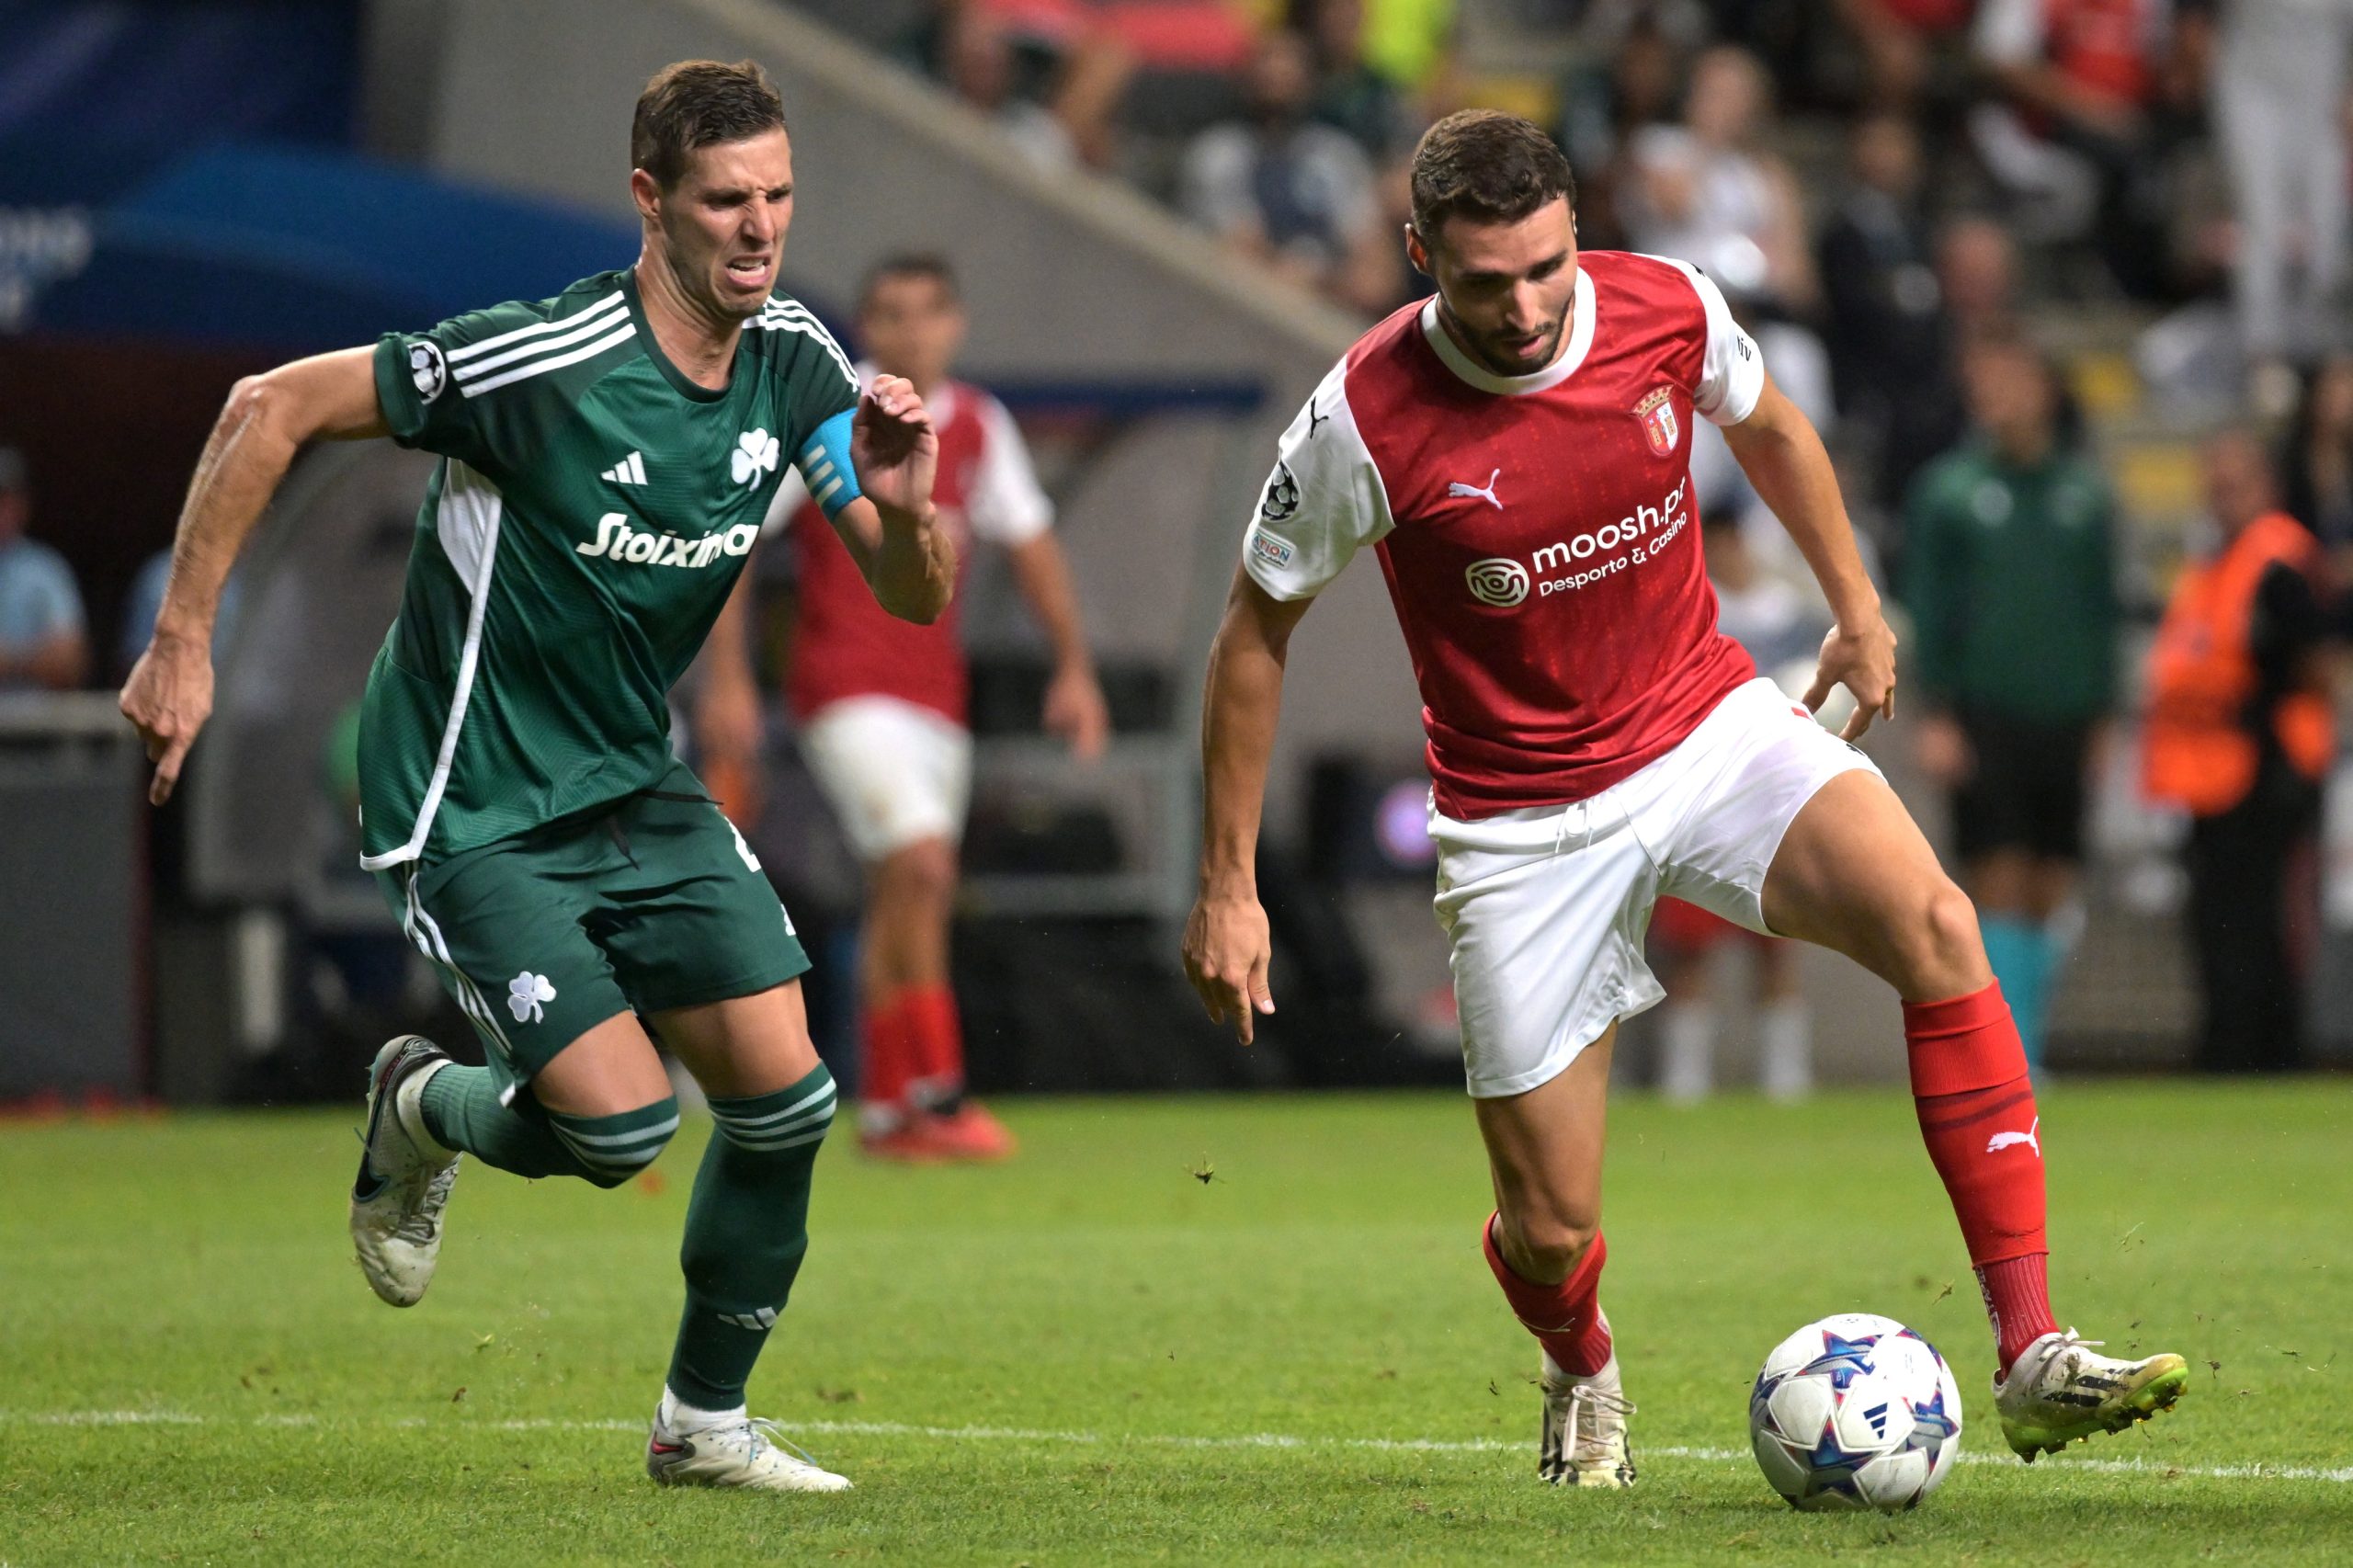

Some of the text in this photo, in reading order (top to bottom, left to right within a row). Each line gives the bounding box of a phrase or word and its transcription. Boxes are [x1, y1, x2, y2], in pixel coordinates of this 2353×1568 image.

[1539, 512, 1687, 597] Desporto & Casino
